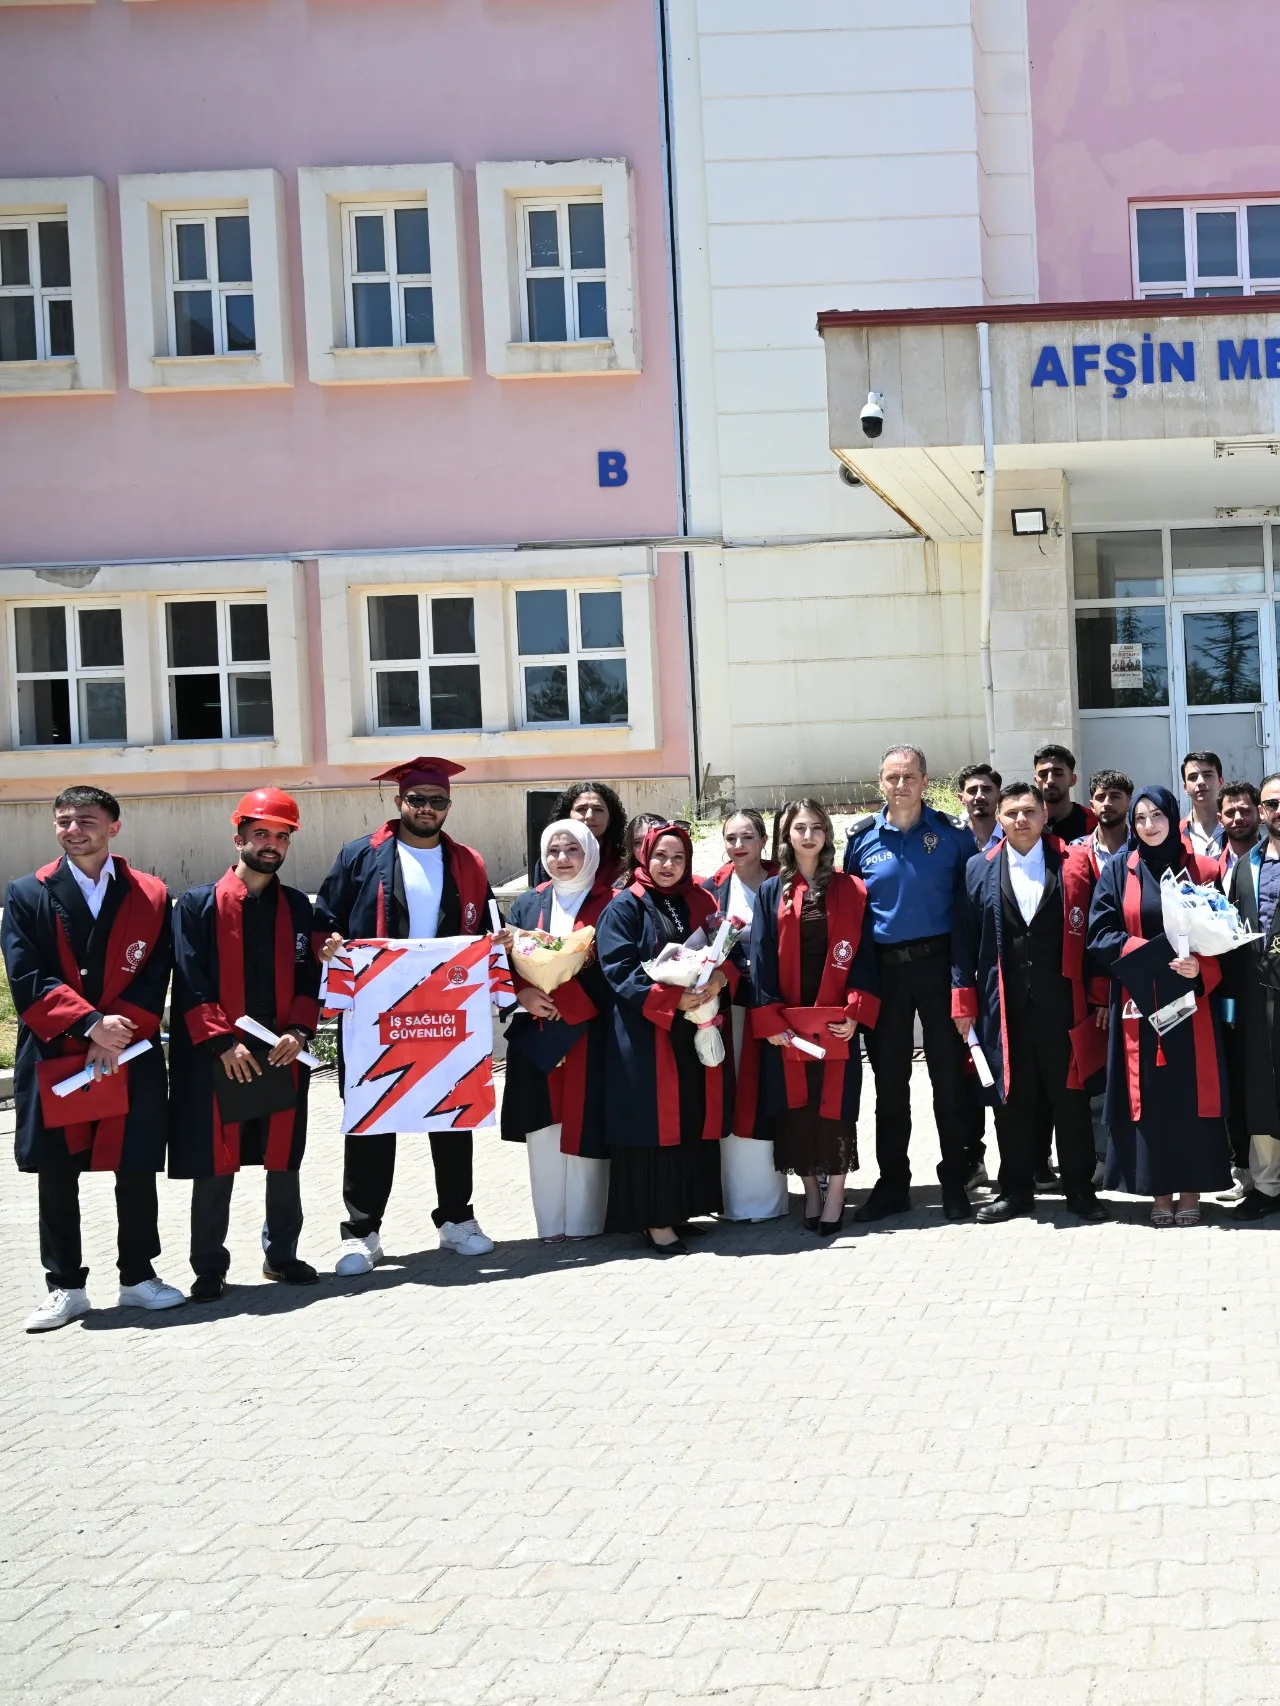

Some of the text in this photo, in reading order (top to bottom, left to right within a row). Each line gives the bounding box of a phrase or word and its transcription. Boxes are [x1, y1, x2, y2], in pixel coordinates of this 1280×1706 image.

[1031, 333, 1196, 399] AFŞİN
[598, 451, 628, 487] B
[389, 1025, 457, 1040] GÜVENLİĞİ
[390, 1013, 456, 1028] İŞ SAĞLIĞI
